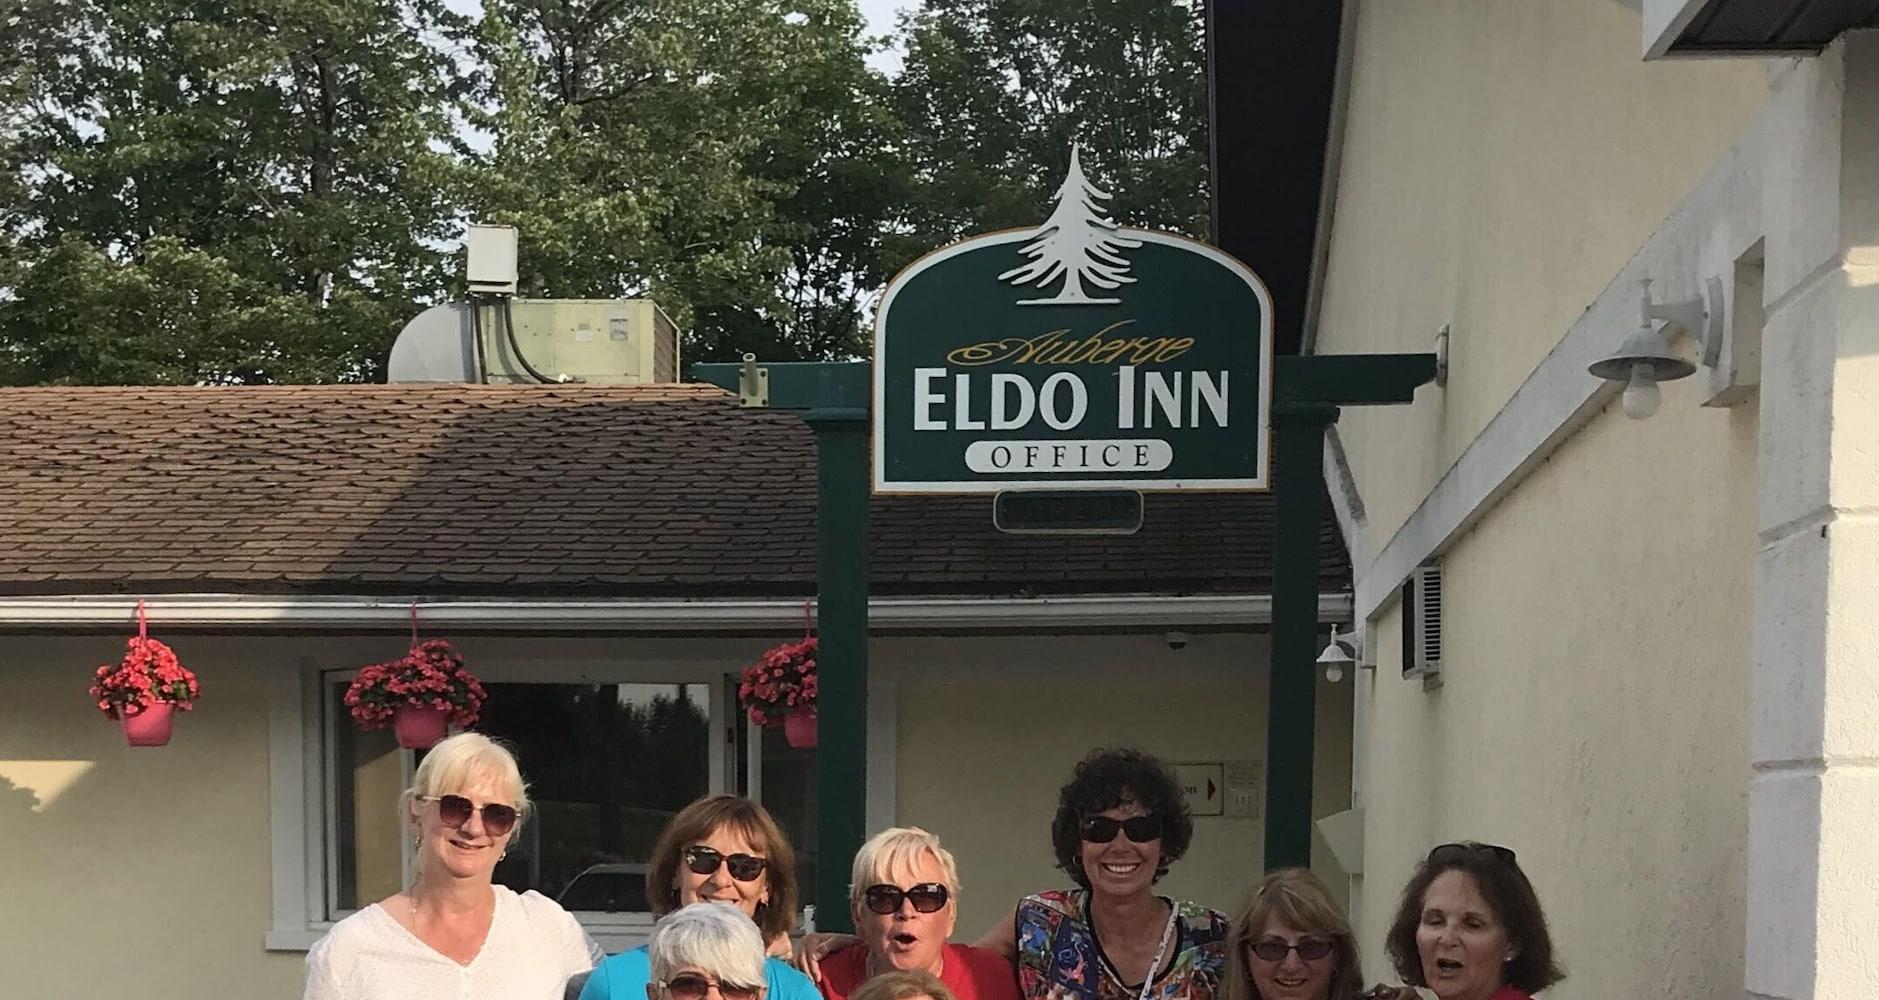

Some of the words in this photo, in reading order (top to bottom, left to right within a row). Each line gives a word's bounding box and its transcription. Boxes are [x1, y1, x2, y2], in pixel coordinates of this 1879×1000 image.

[947, 319, 1195, 376] Auberge
[913, 367, 1088, 431] ELDO
[1118, 365, 1229, 429] INN
[991, 444, 1150, 468] OFFICE
